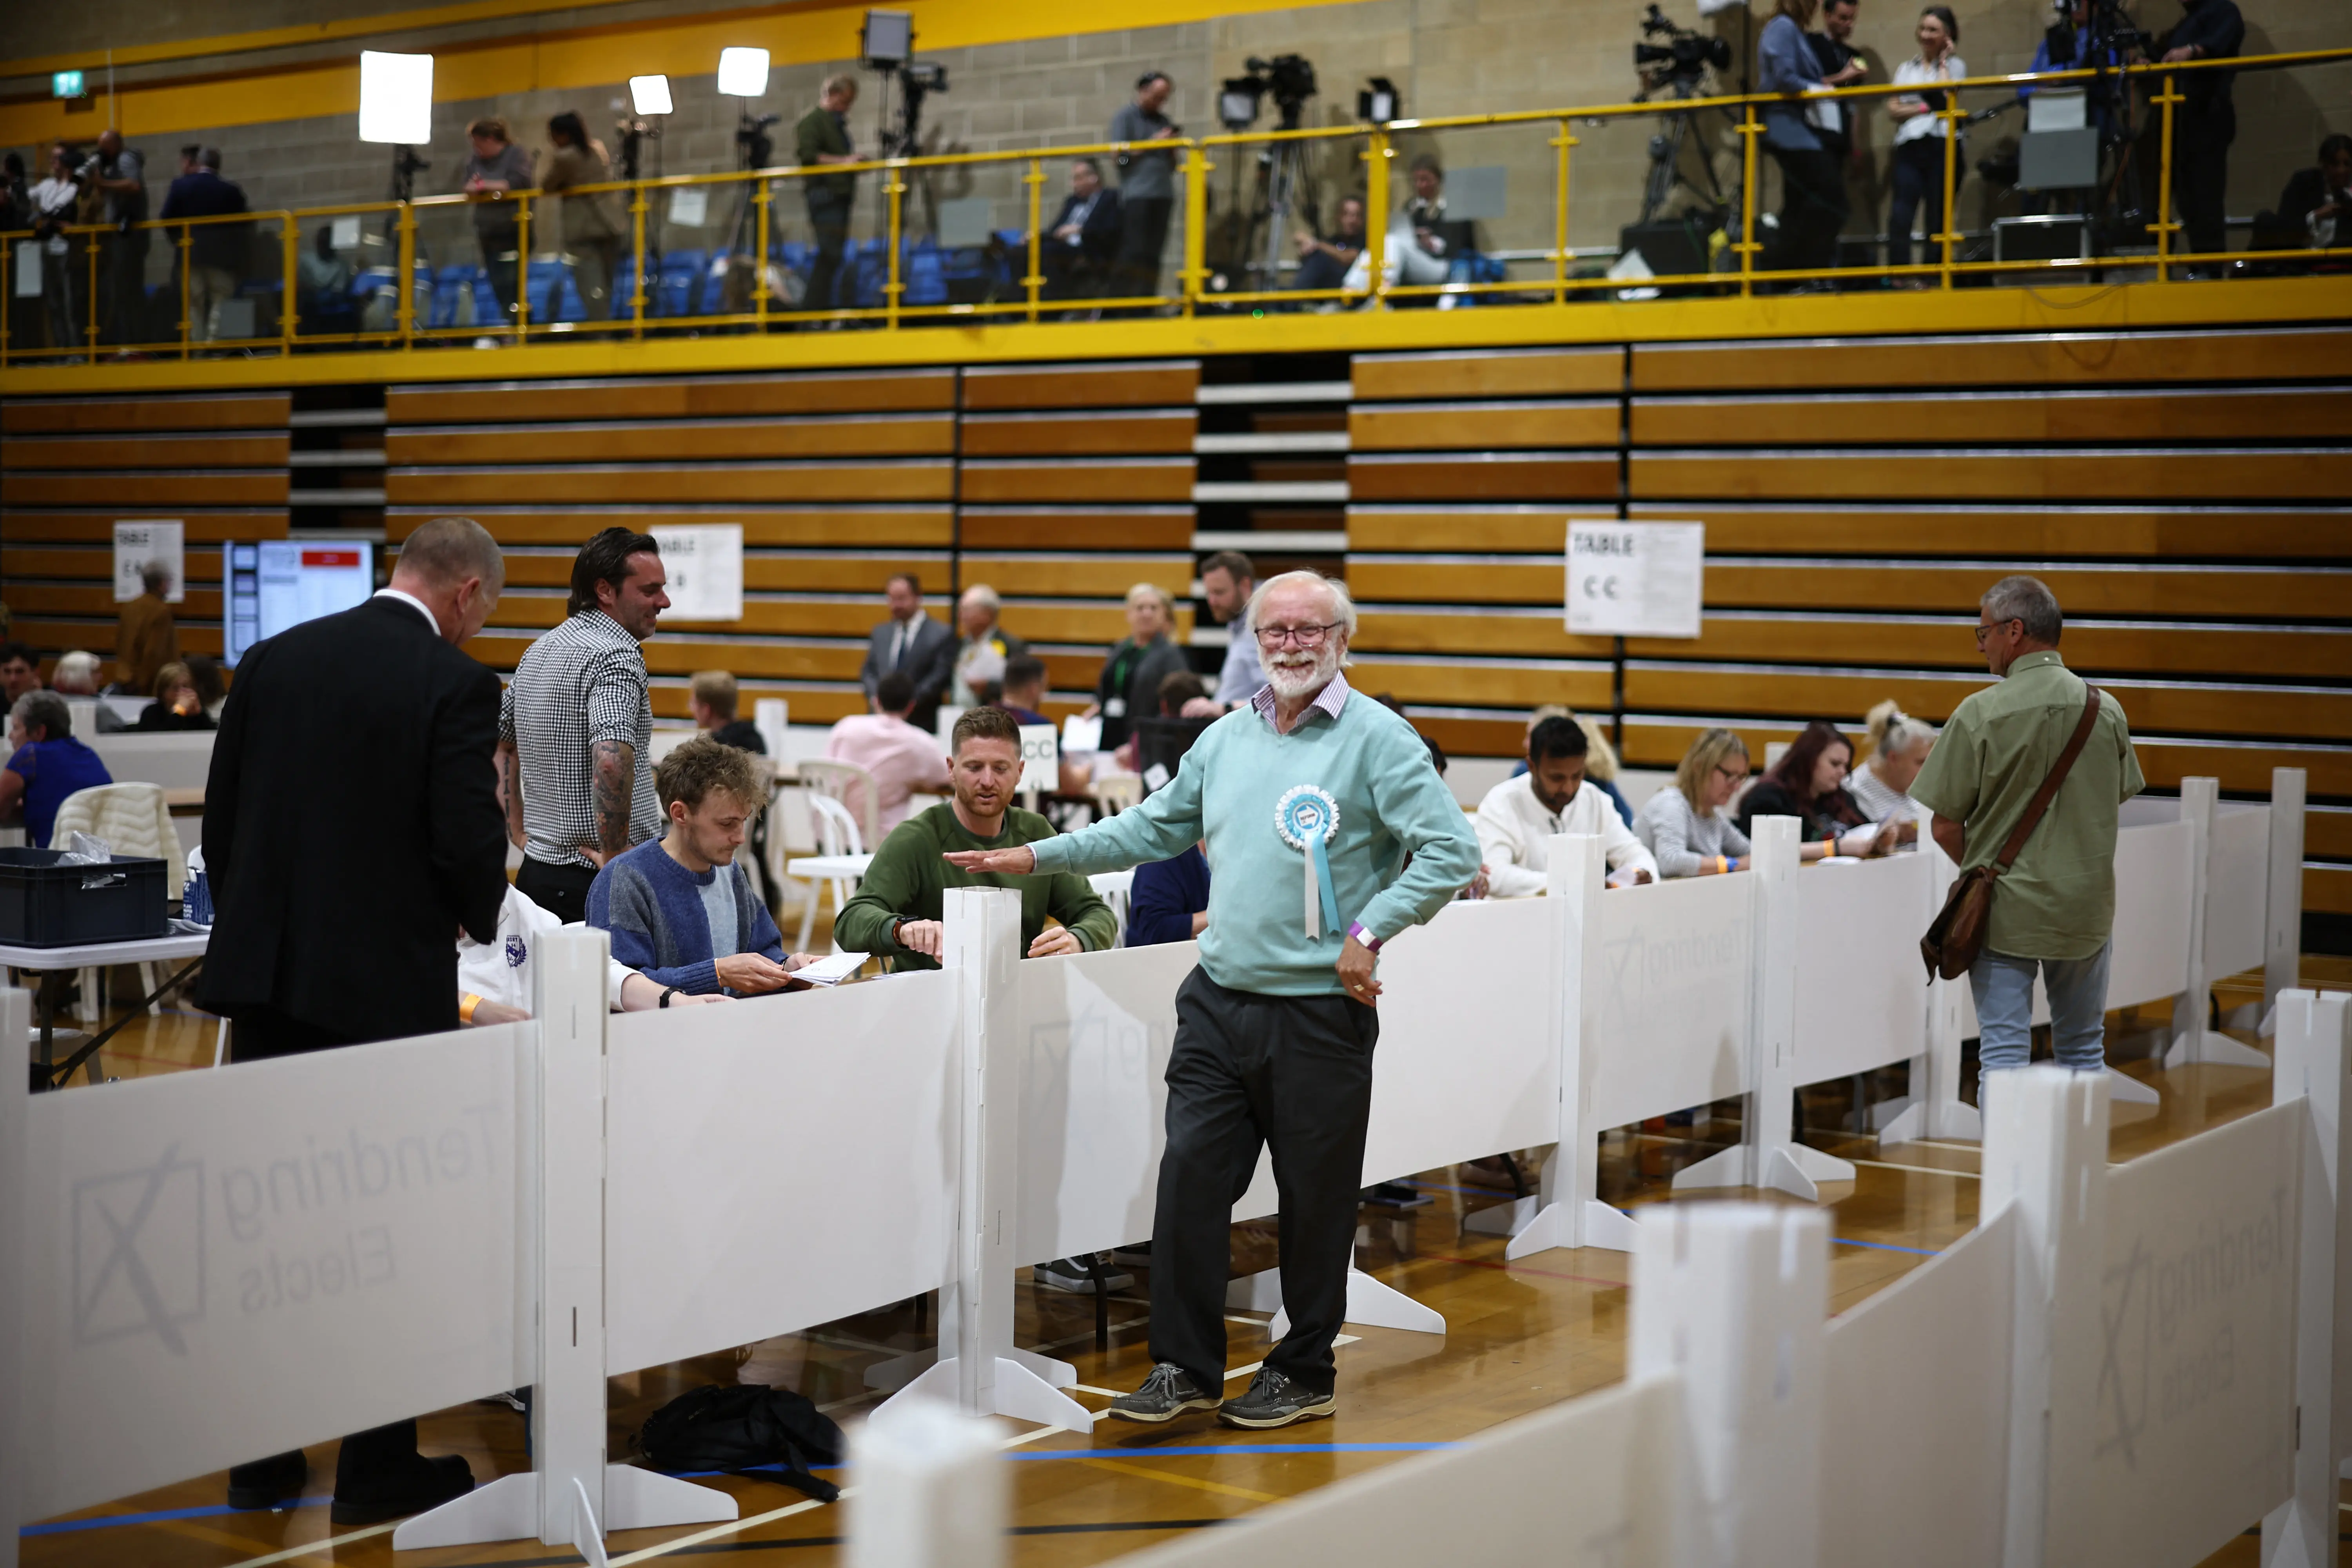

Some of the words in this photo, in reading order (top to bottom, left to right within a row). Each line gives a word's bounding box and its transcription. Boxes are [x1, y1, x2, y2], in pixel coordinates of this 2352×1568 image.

[657, 535, 695, 557] ABLE
[1574, 533, 1634, 557] TABLE
[1022, 739, 1054, 760] CC
